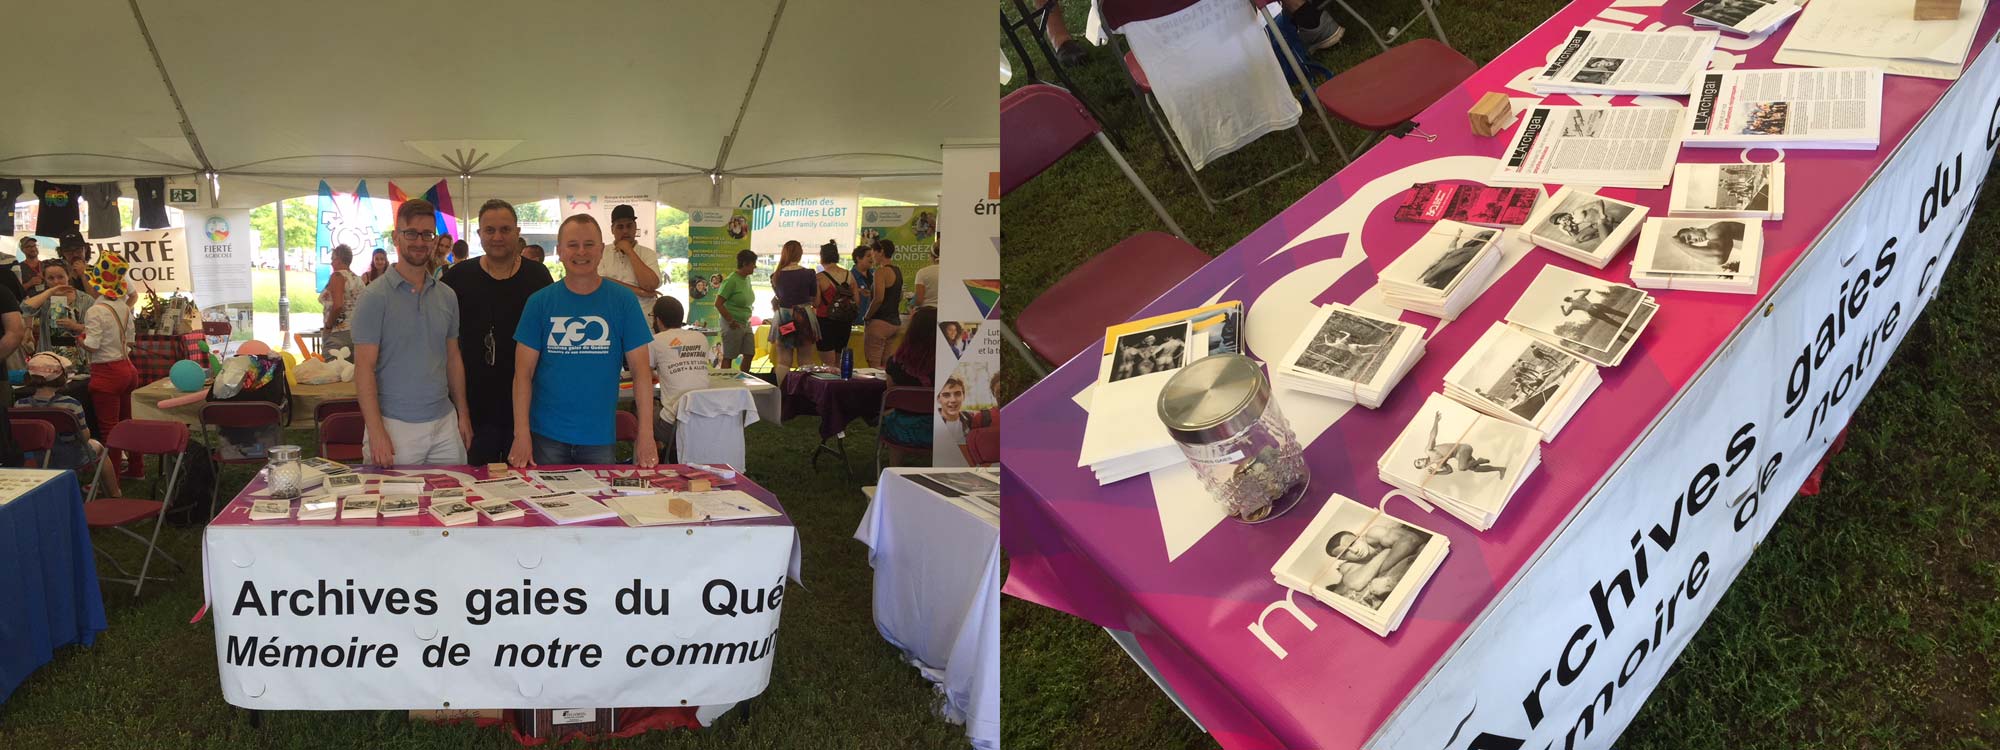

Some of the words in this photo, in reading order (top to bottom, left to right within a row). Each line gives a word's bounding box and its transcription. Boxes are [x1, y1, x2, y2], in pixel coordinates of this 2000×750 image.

[1693, 80, 1718, 124] L'Archigai
[1514, 115, 1543, 160] L'Archigai
[779, 207, 819, 217] Familles
[821, 207, 848, 217] LGBT
[780, 197, 818, 206] Coalition
[820, 198, 834, 206] des
[796, 221, 817, 229] Family
[203, 243, 233, 253] FIERTÉ
[894, 244, 930, 253] ANGEZ
[128, 266, 175, 282] COLE
[1783, 236, 1898, 419] gaies
[1918, 151, 1962, 234] du
[1543, 551, 1710, 750] moire
[1732, 452, 1783, 533] de
[1805, 301, 1901, 443] notre
[233, 579, 438, 617] Archives
[465, 578, 588, 625] gaies
[615, 578, 669, 616] du
[702, 574, 785, 618] Qué
[227, 635, 399, 668] Mémoire
[422, 636, 471, 667] de
[494, 637, 603, 668] notre
